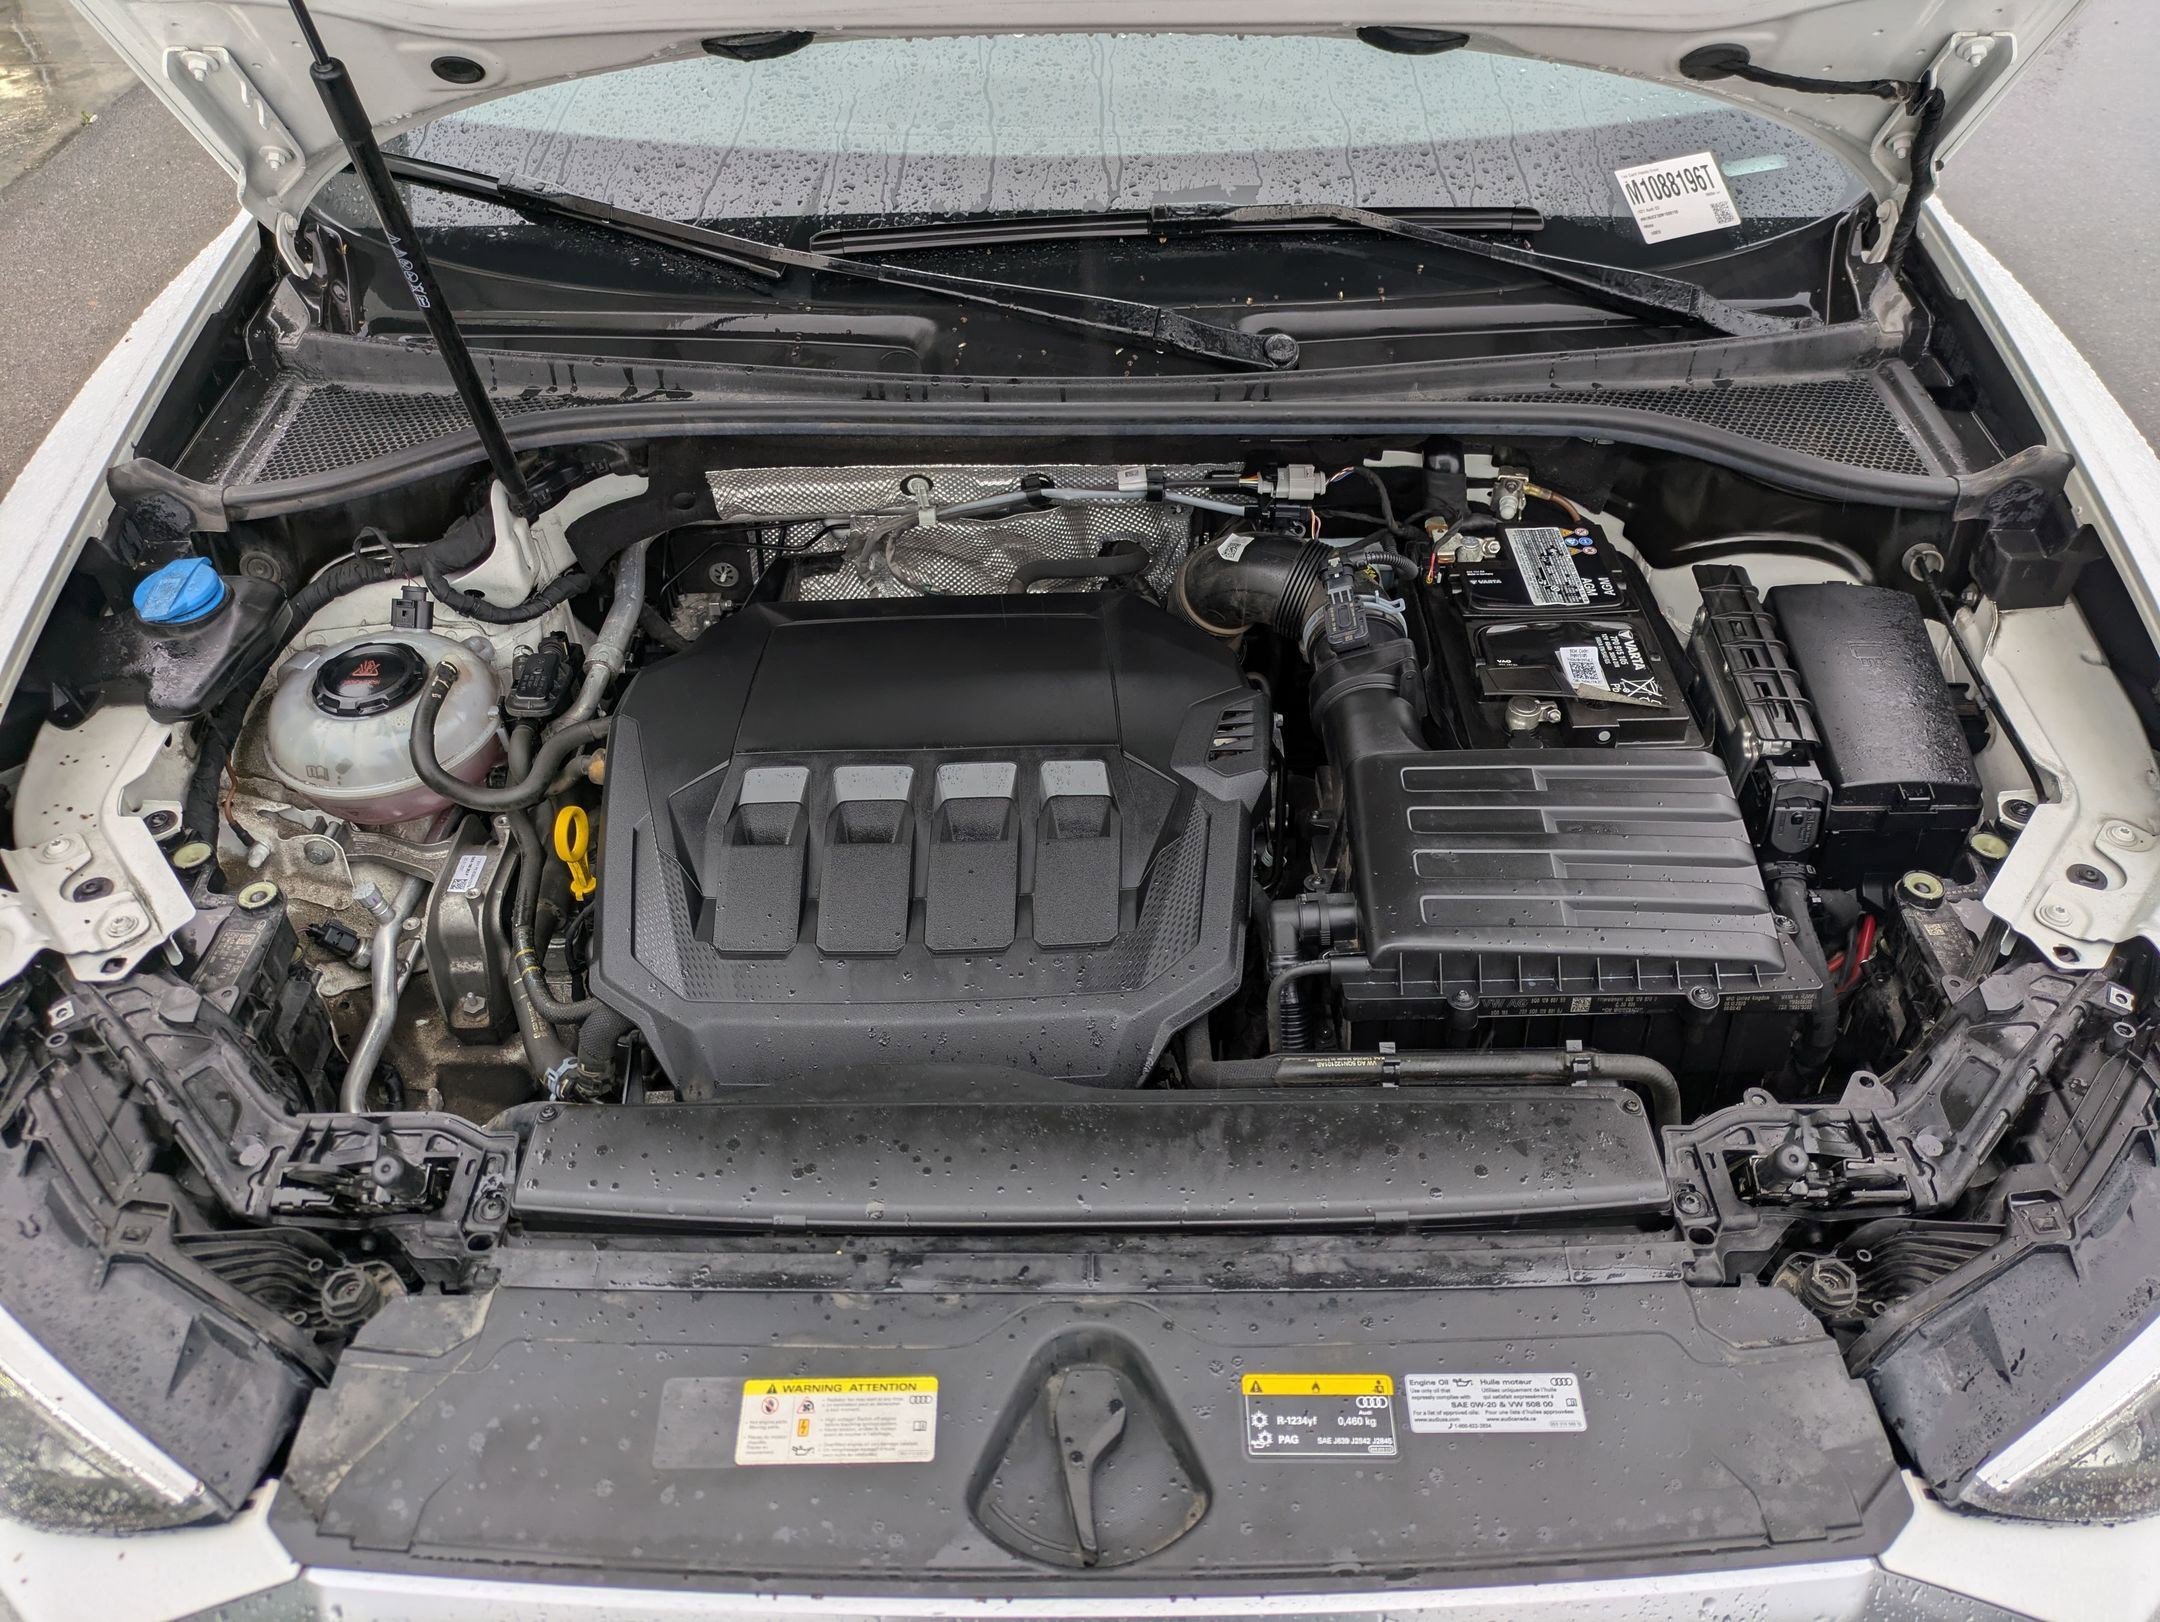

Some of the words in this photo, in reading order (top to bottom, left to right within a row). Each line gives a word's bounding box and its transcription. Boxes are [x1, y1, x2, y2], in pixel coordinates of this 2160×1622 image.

[1625, 164, 1715, 206] M1088196T
[1581, 577, 1599, 596] AGM
[1597, 577, 1617, 596] AGM
[1624, 640, 1646, 671] VARTA
[1481, 998, 1506, 1008] VW
[1507, 997, 1529, 1008] AG
[782, 1384, 842, 1393] WARNING
[848, 1383, 917, 1392] ATTENTION
[1409, 1379, 1436, 1387] Engine
[1276, 1416, 1318, 1427] R-1234yf
[1337, 1416, 1364, 1427] 0,460
[1365, 1416, 1377, 1428] kg
[1278, 1435, 1300, 1444] PAG
